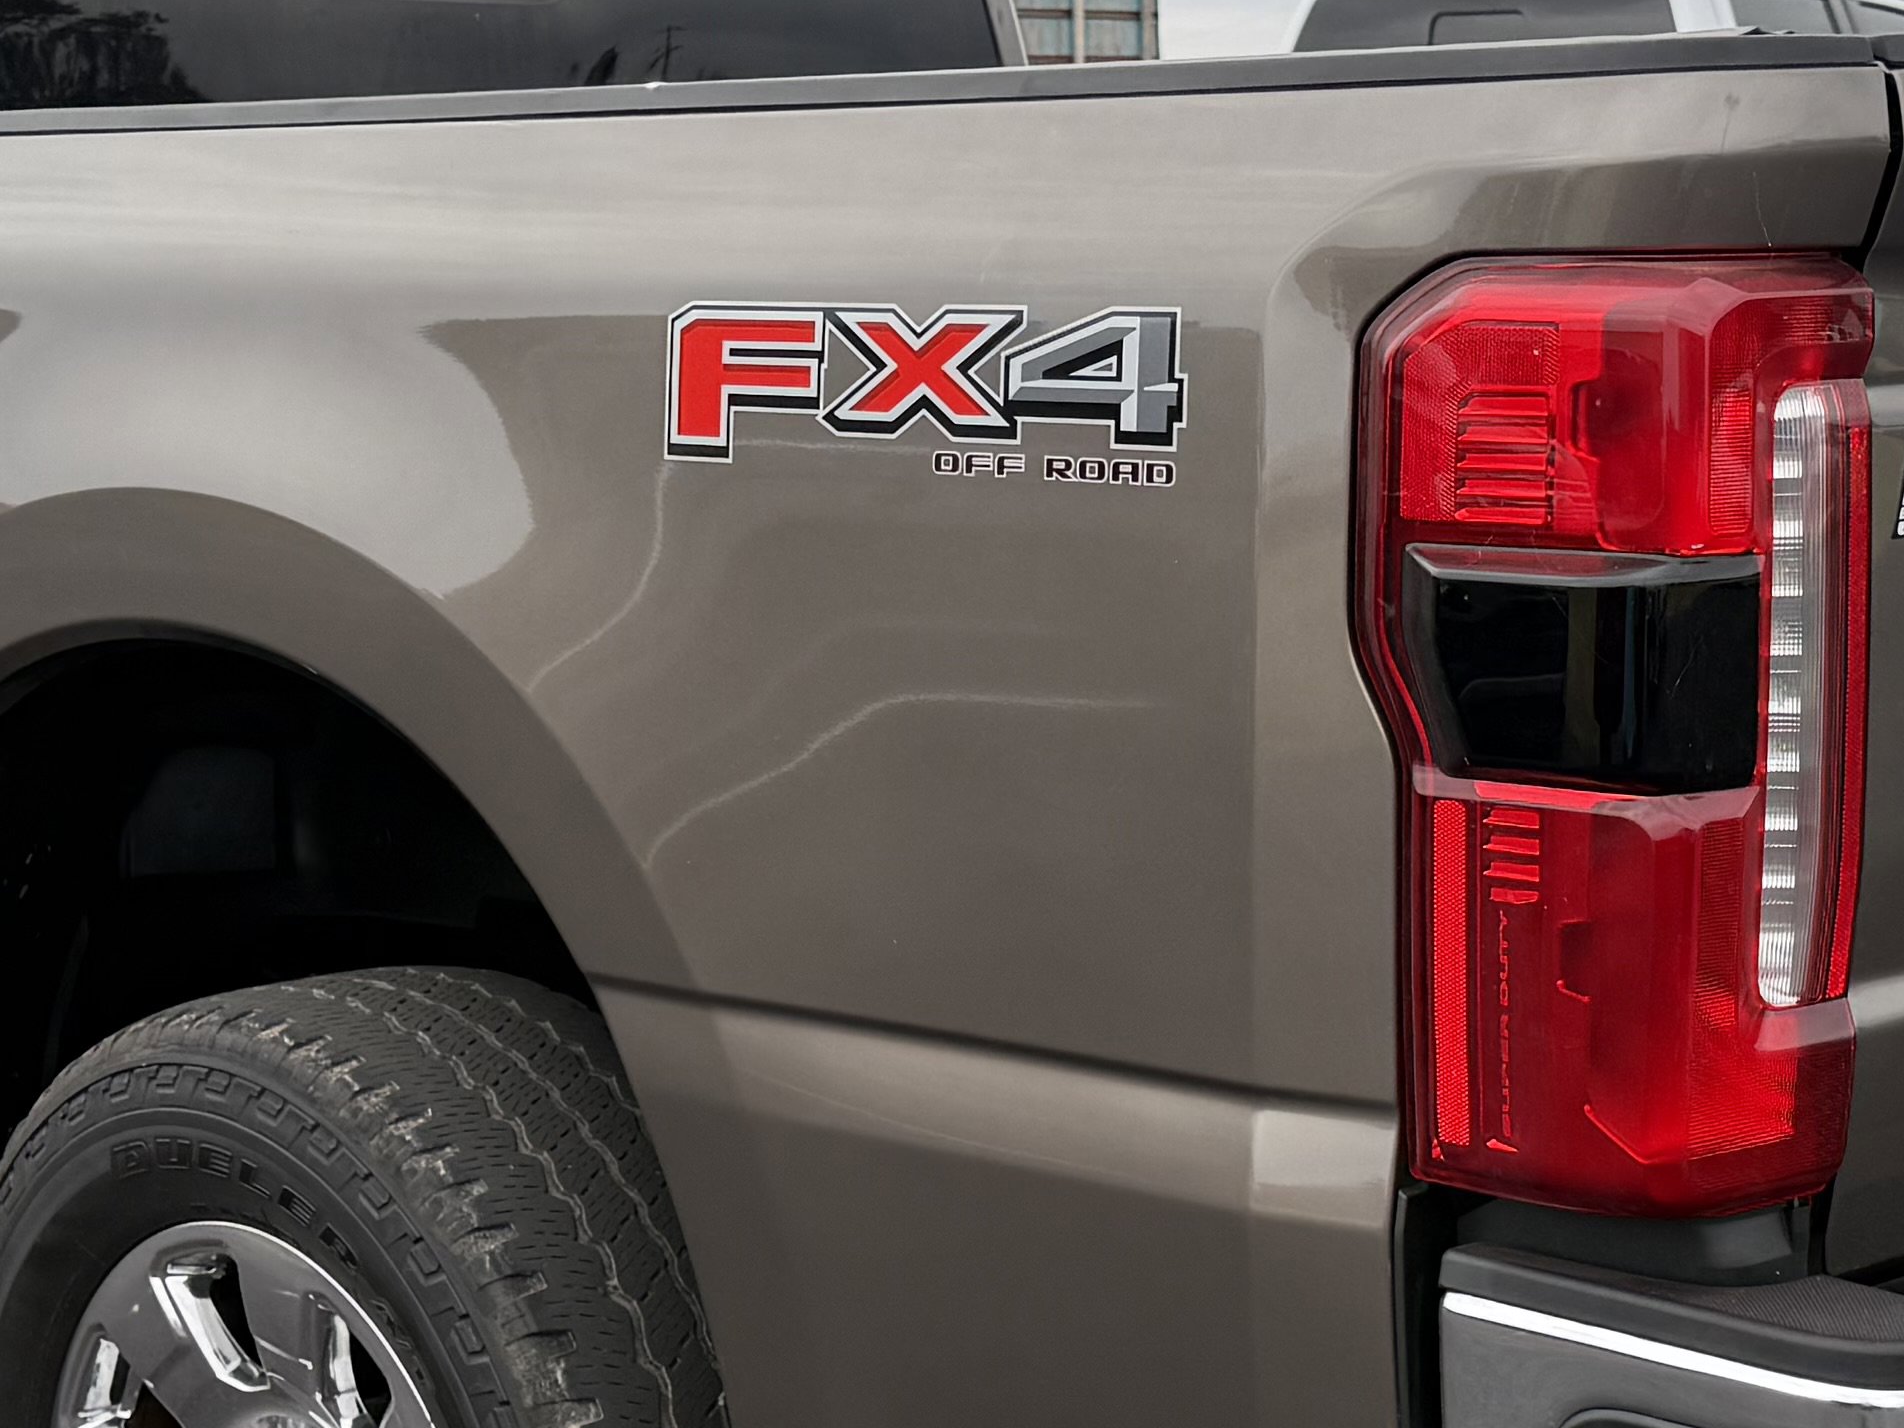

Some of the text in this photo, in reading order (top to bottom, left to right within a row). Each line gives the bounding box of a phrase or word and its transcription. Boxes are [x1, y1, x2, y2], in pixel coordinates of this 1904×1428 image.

[664, 300, 1187, 463] FX4
[932, 451, 1176, 488] OFF ROAD
[1498, 909, 1510, 1007] DUTY
[108, 1135, 360, 1276] DUELER
